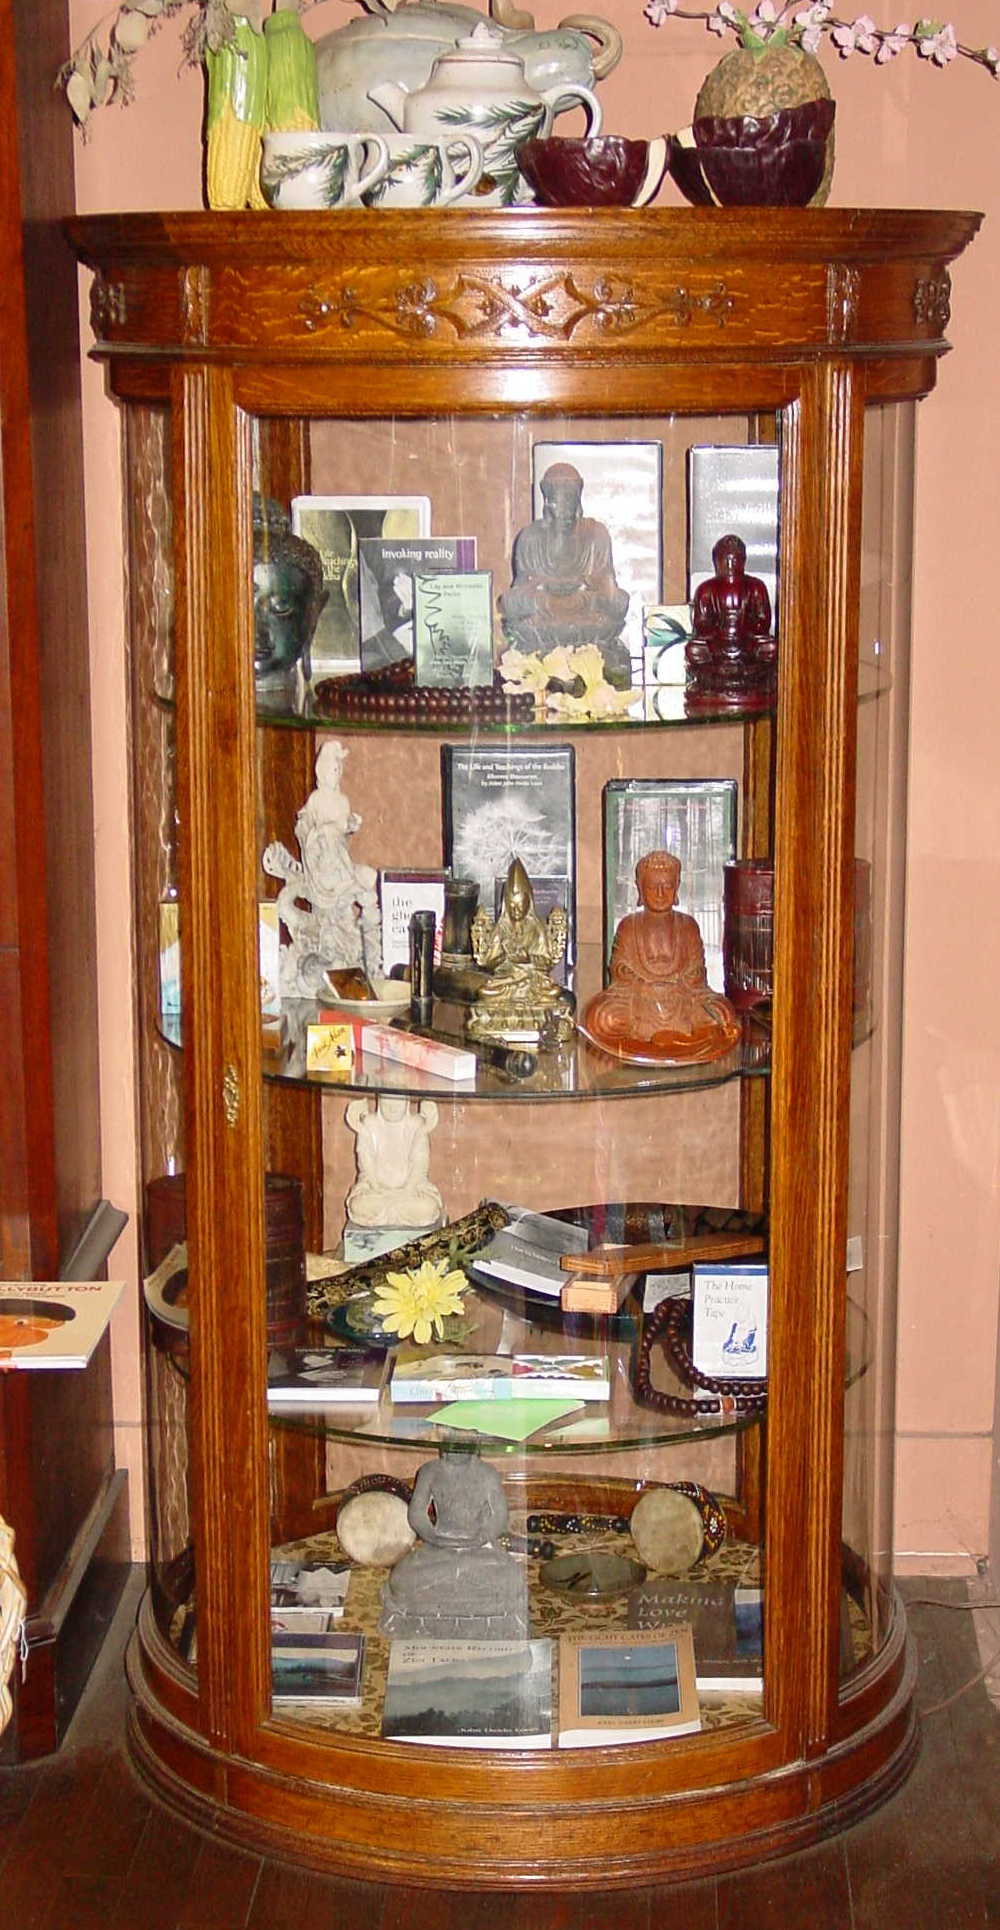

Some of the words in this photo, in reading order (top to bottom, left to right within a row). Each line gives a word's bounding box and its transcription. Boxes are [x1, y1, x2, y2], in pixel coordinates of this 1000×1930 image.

[382, 547, 422, 561] invoking
[424, 546, 455, 561] reality
[392, 896, 412, 908] the
[704, 1281, 722, 1291] The
[725, 1280, 752, 1291] Home
[638, 1593, 724, 1607] Making
[638, 1607, 688, 1618] Love
